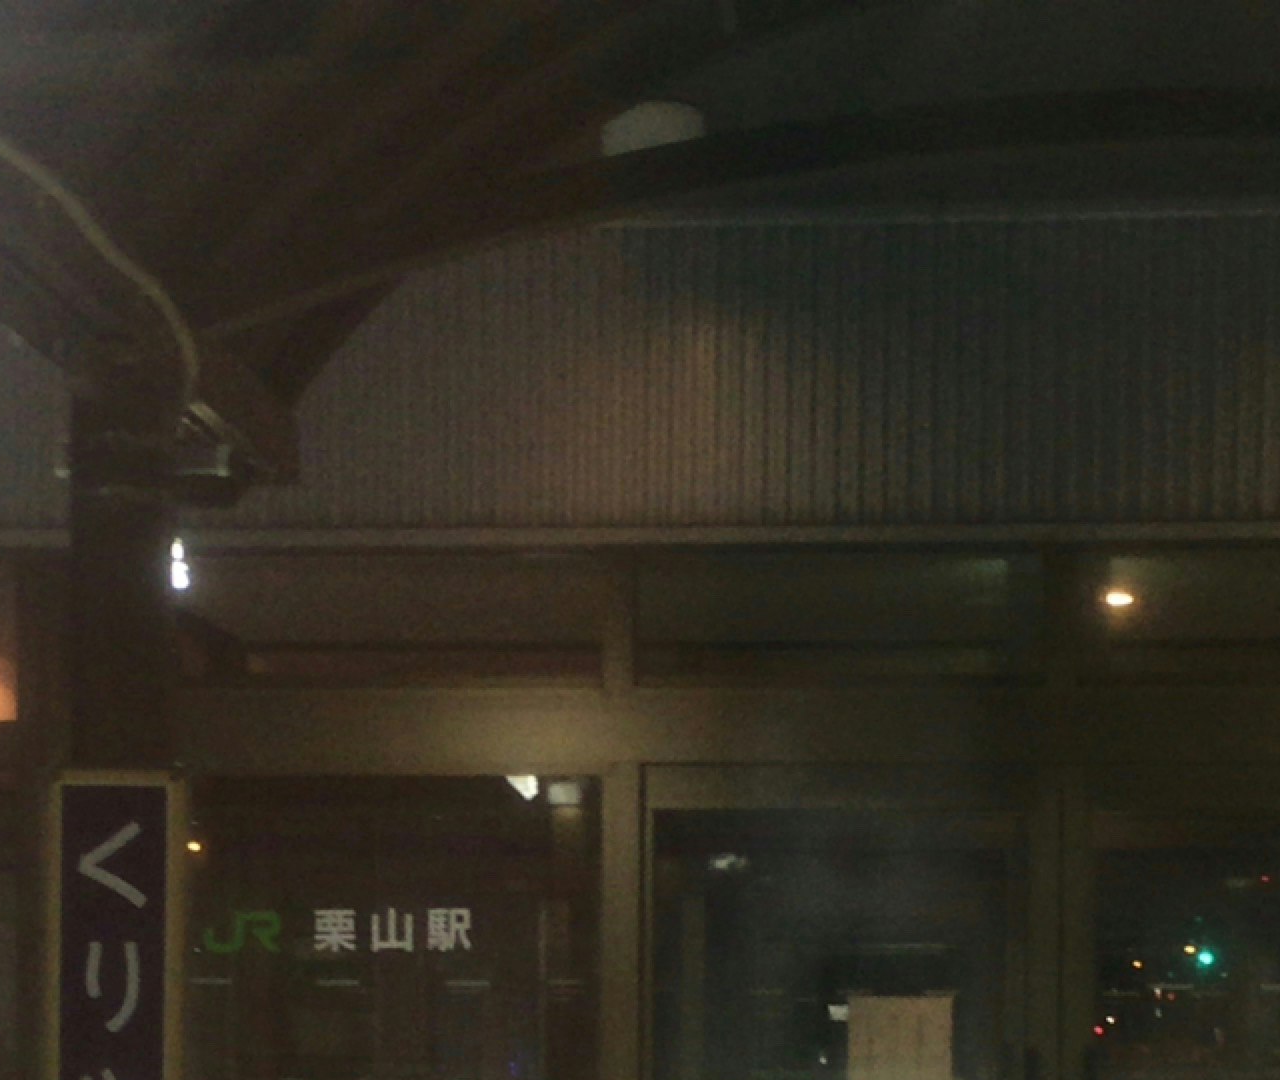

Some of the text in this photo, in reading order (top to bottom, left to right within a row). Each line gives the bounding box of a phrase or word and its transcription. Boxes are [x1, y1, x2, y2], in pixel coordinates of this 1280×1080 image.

[203, 907, 471, 953] JR 栗山駅
